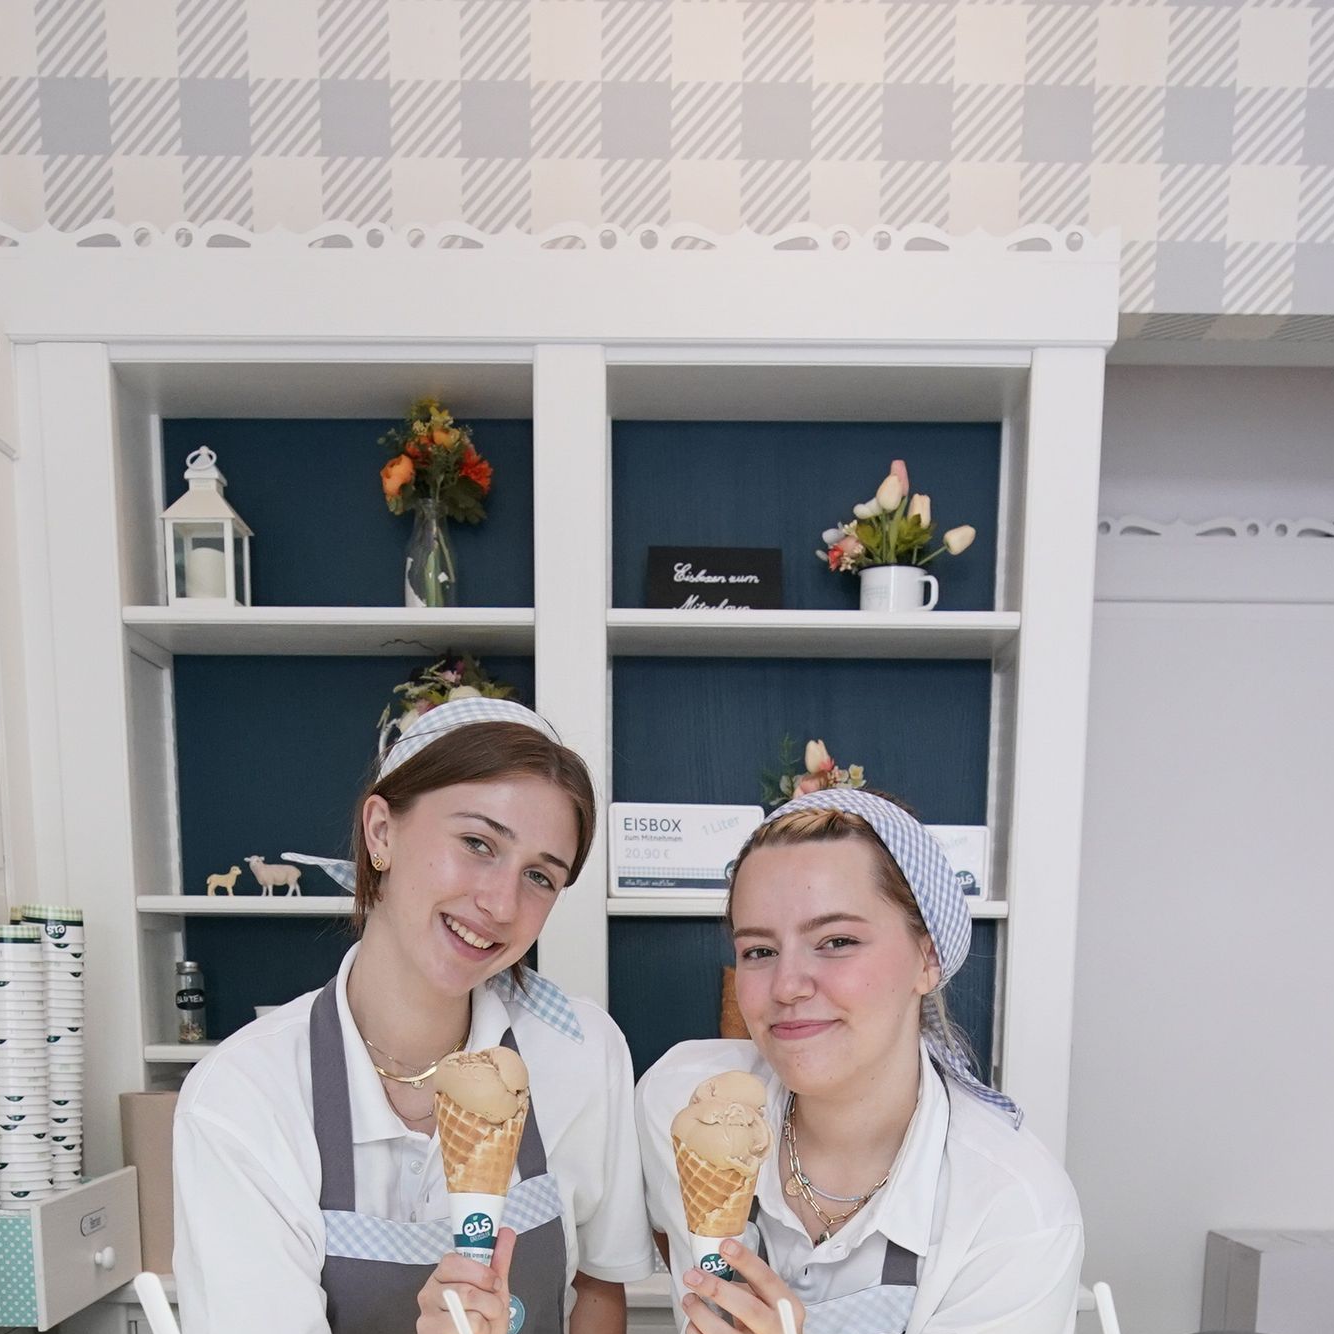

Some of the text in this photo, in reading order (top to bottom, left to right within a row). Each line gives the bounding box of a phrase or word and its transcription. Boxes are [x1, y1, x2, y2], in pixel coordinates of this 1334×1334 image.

[624, 817, 682, 833] EISBOX
[464, 1215, 492, 1238] eis
[702, 1256, 728, 1273] eis
